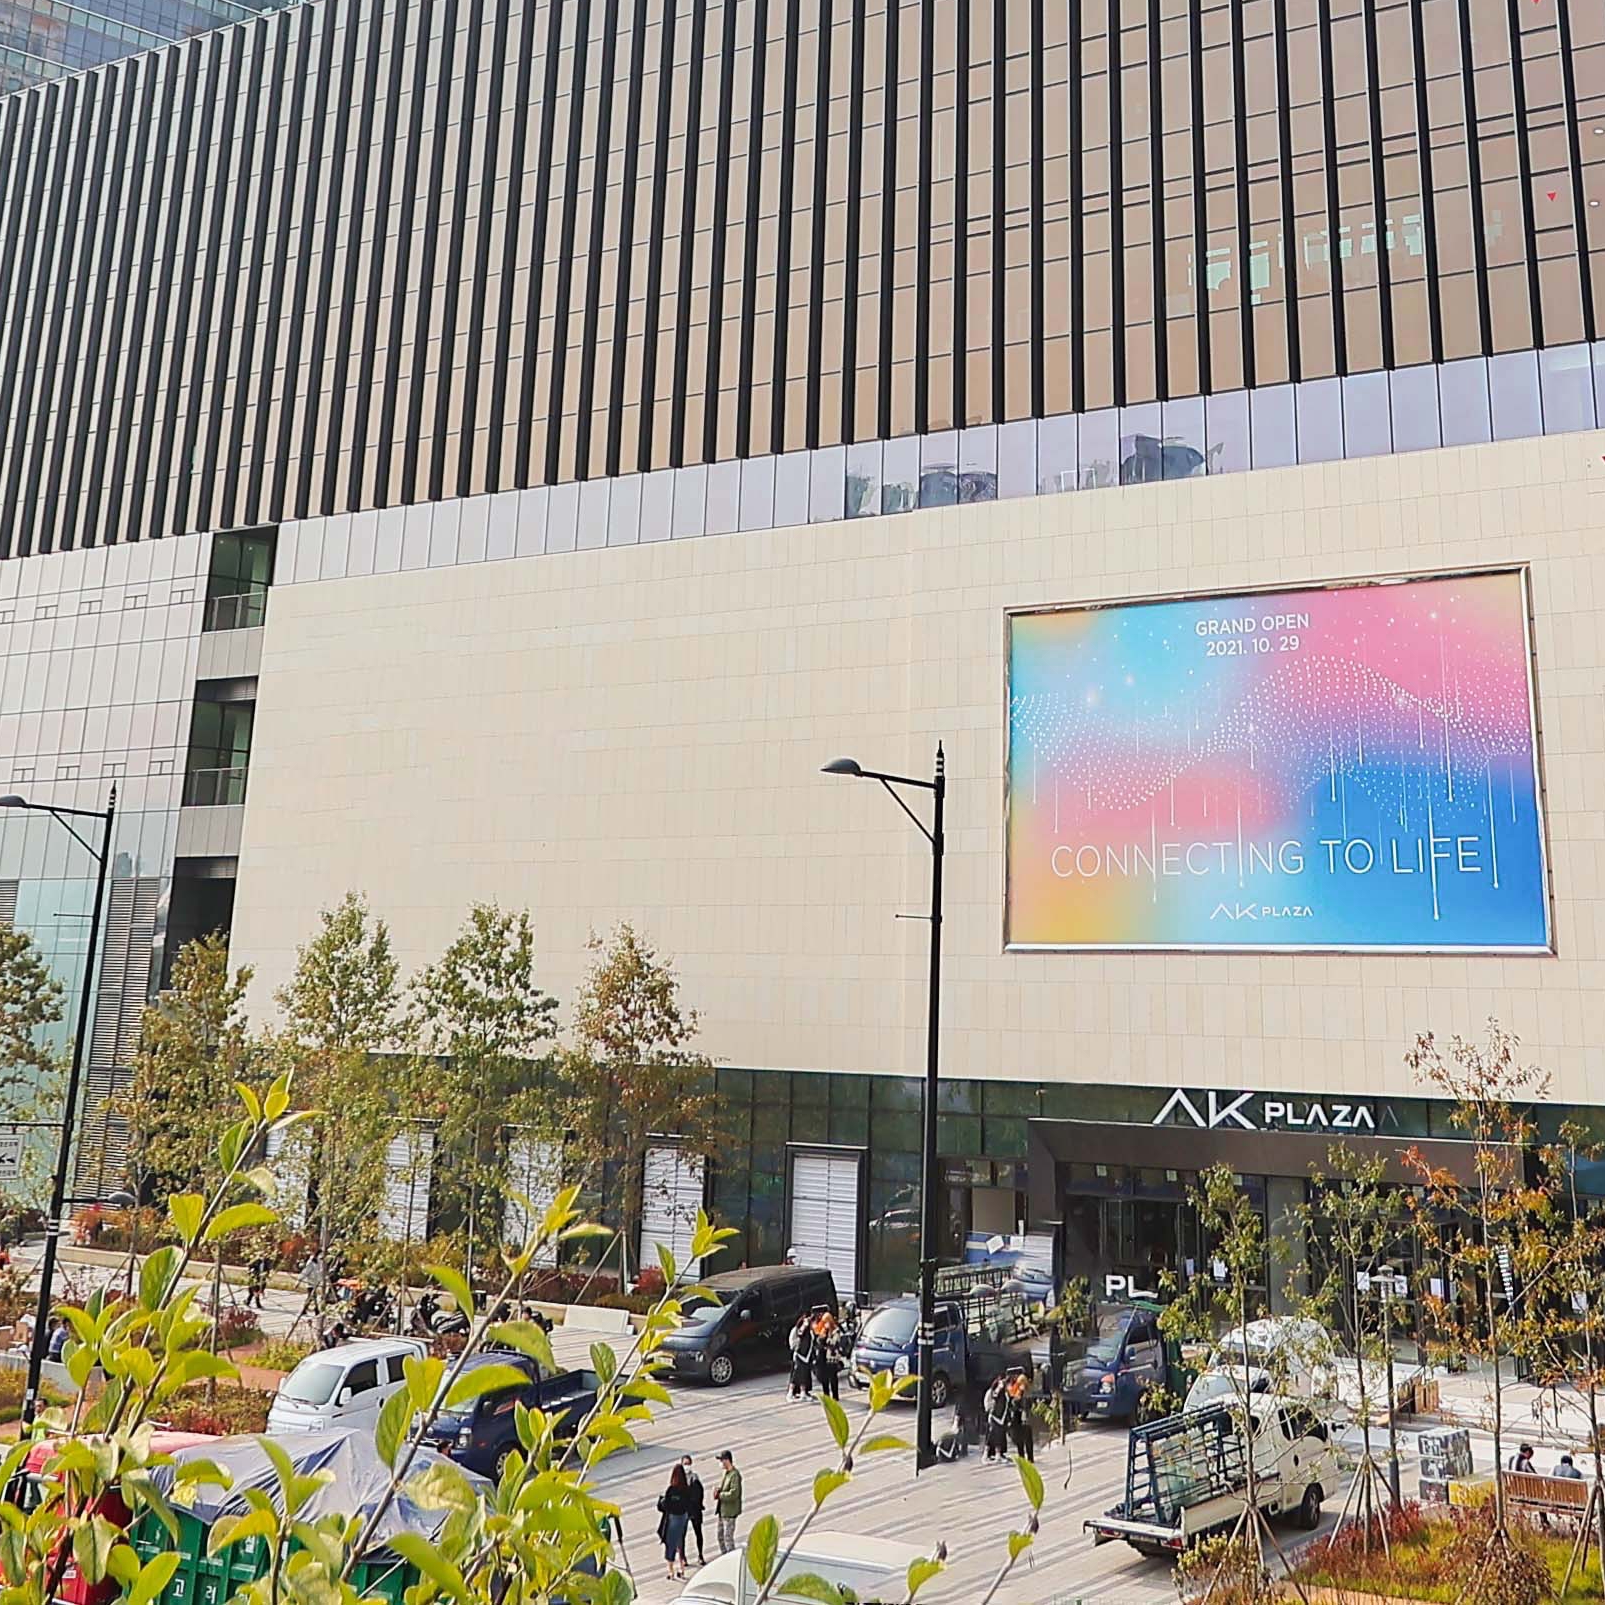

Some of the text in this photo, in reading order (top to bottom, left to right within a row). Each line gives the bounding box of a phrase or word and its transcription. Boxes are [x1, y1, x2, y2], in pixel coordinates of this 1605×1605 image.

[1195, 613, 1309, 636] GRAND OPEN
[1206, 635, 1300, 656] 2021. 10. 29
[1051, 836, 1482, 878] CONNECTING TO LIFE
[1210, 902, 1314, 921] AK PLAZA
[1152, 1088, 1376, 1130] AK PLAZA
